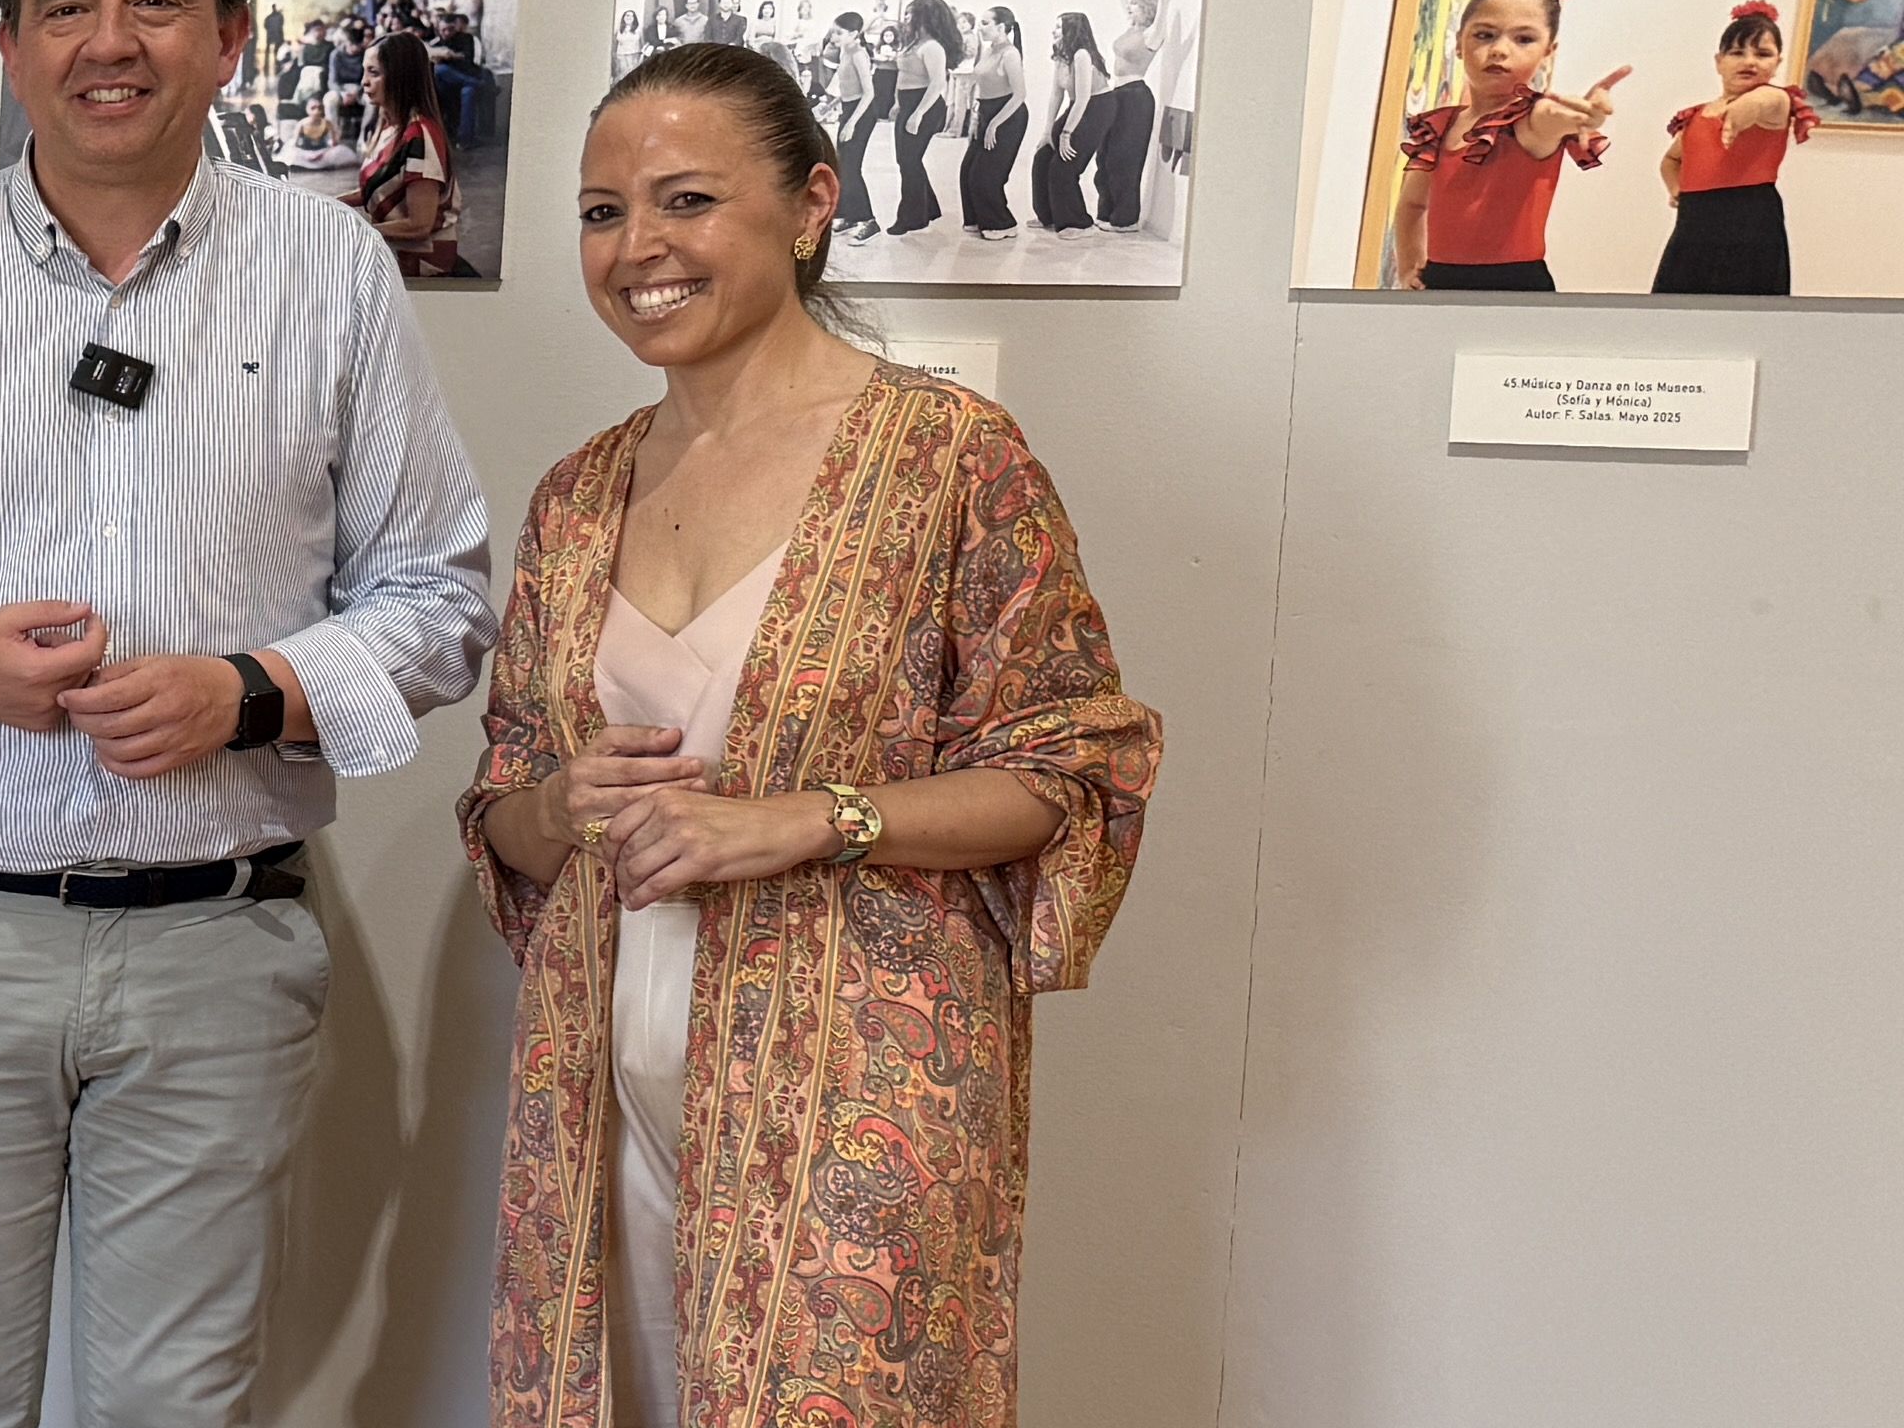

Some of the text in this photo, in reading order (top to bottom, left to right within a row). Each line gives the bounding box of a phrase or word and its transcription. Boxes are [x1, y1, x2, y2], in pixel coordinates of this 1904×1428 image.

[1566, 382, 1573, 392] y
[1576, 380, 1612, 391] Danza
[1616, 382, 1630, 392] en
[1634, 381, 1653, 392] los
[1657, 382, 1706, 393] Museos.
[1557, 394, 1652, 408] (Sofía y Mónica)
[1525, 408, 1681, 424] Autor: F. Salas. Mayo 2025
